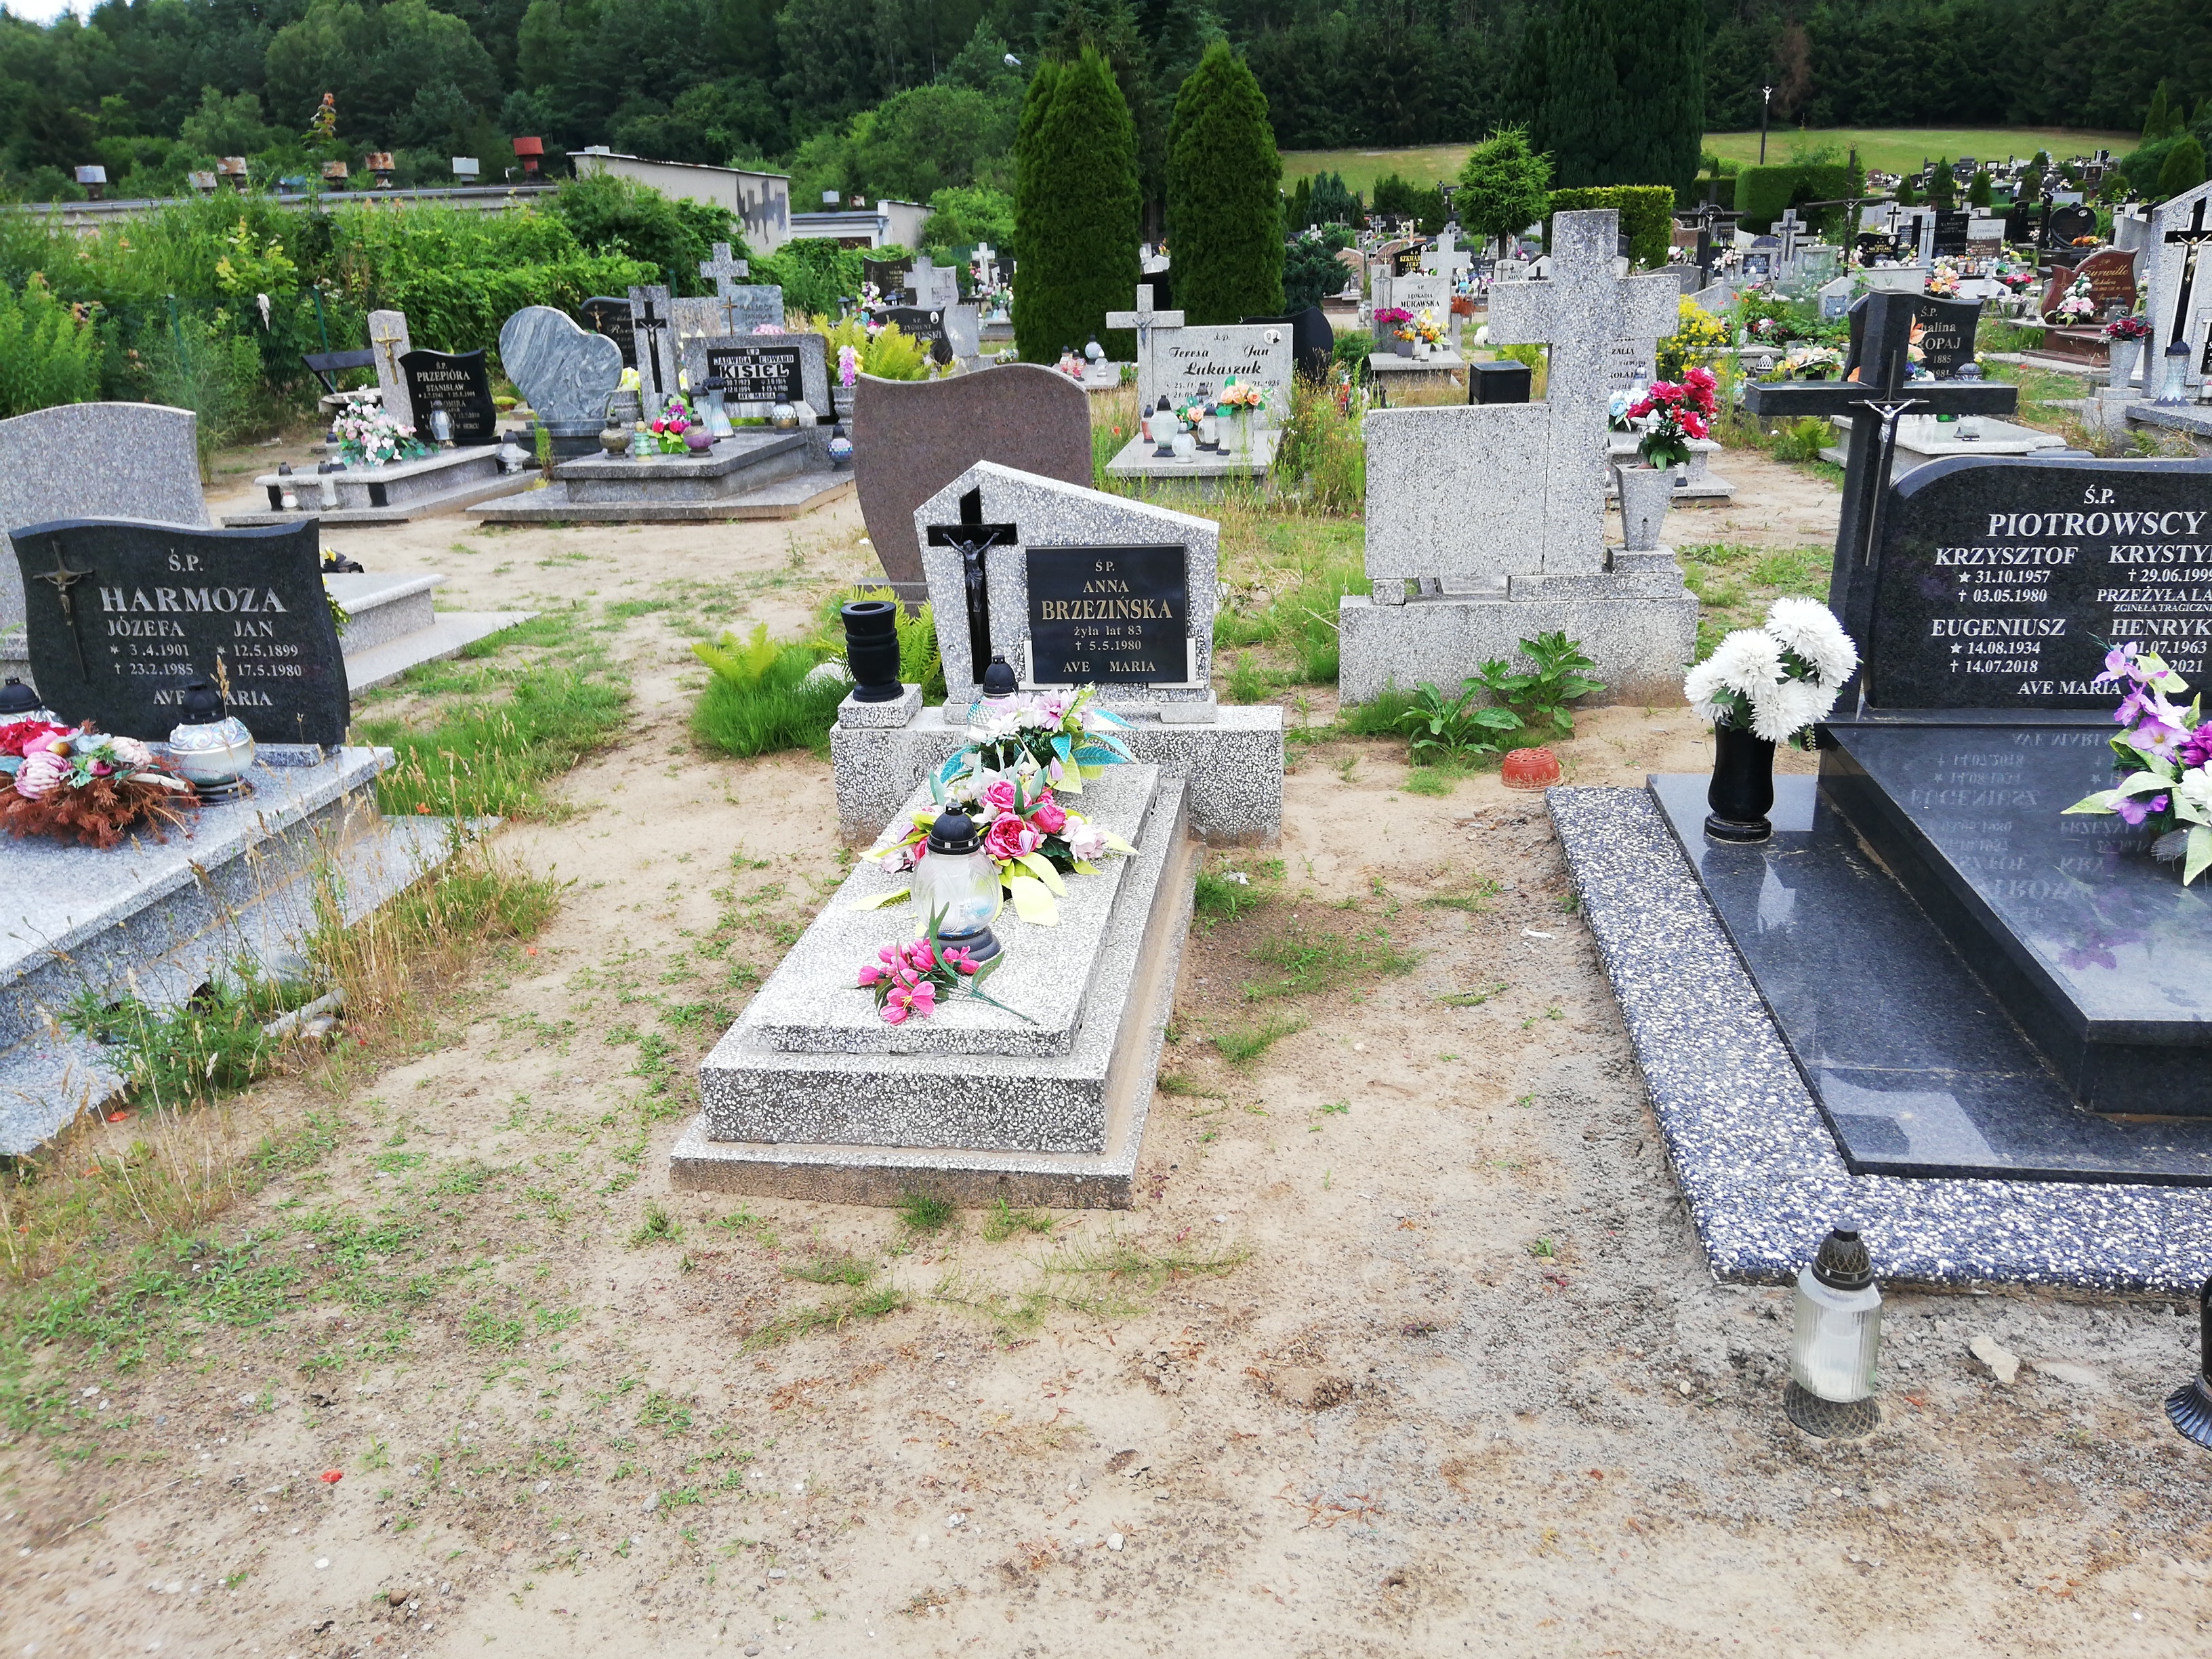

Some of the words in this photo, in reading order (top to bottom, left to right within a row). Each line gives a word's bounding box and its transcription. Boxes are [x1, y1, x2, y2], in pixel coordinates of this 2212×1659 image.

[1921, 322, 1957, 333] halina
[1916, 337, 1961, 350] ROPAJ
[1169, 346, 1209, 358] Teresa
[1244, 344, 1269, 358] Jan
[714, 356, 752, 365] JADWIGA
[759, 354, 794, 363] EDWARD
[1933, 354, 1952, 364] 1885
[416, 369, 470, 382] PRZEPIÓRA
[720, 364, 790, 378] KISIEL
[2084, 485, 2114, 504] Ś.P.
[1986, 511, 2207, 537] PIOTROWSCY
[168, 548, 204, 572] Ś.P.
[1934, 546, 2078, 565] KRZYSZTOF
[1975, 570, 2051, 583] 31.10.1957
[1082, 579, 1130, 593] ANNA
[99, 586, 288, 613] HARMOZA
[1973, 588, 2047, 602] 03.05.1980
[2096, 586, 2188, 602] PRZEŻYŁA
[1041, 595, 1173, 620] BRZEZIŃSKA
[107, 615, 186, 637] JÓZEFA
[234, 619, 274, 638] JAN
[1073, 626, 1099, 638] żyła
[1105, 625, 1122, 636] lat
[1128, 625, 1143, 636] 83
[1931, 619, 2066, 636] EUGENIUSZ
[2110, 619, 2212, 636] HENRYK
[234, 643, 299, 657] 12.5.1899
[1089, 640, 1142, 651] 5.5.1980
[1967, 641, 2041, 654] 14.08.1934
[2134, 640, 2207, 654] 1.07.1963
[129, 663, 194, 676] 23.2.1985
[238, 663, 302, 677] 17.5.1980
[1063, 661, 1090, 672] AVE
[1109, 660, 1156, 672] MARIA
[1966, 659, 2039, 673] 14.07.2018
[2017, 680, 2054, 695] AVE
[2058, 680, 2122, 695] MARIA
[216, 690, 273, 706] ARIA
